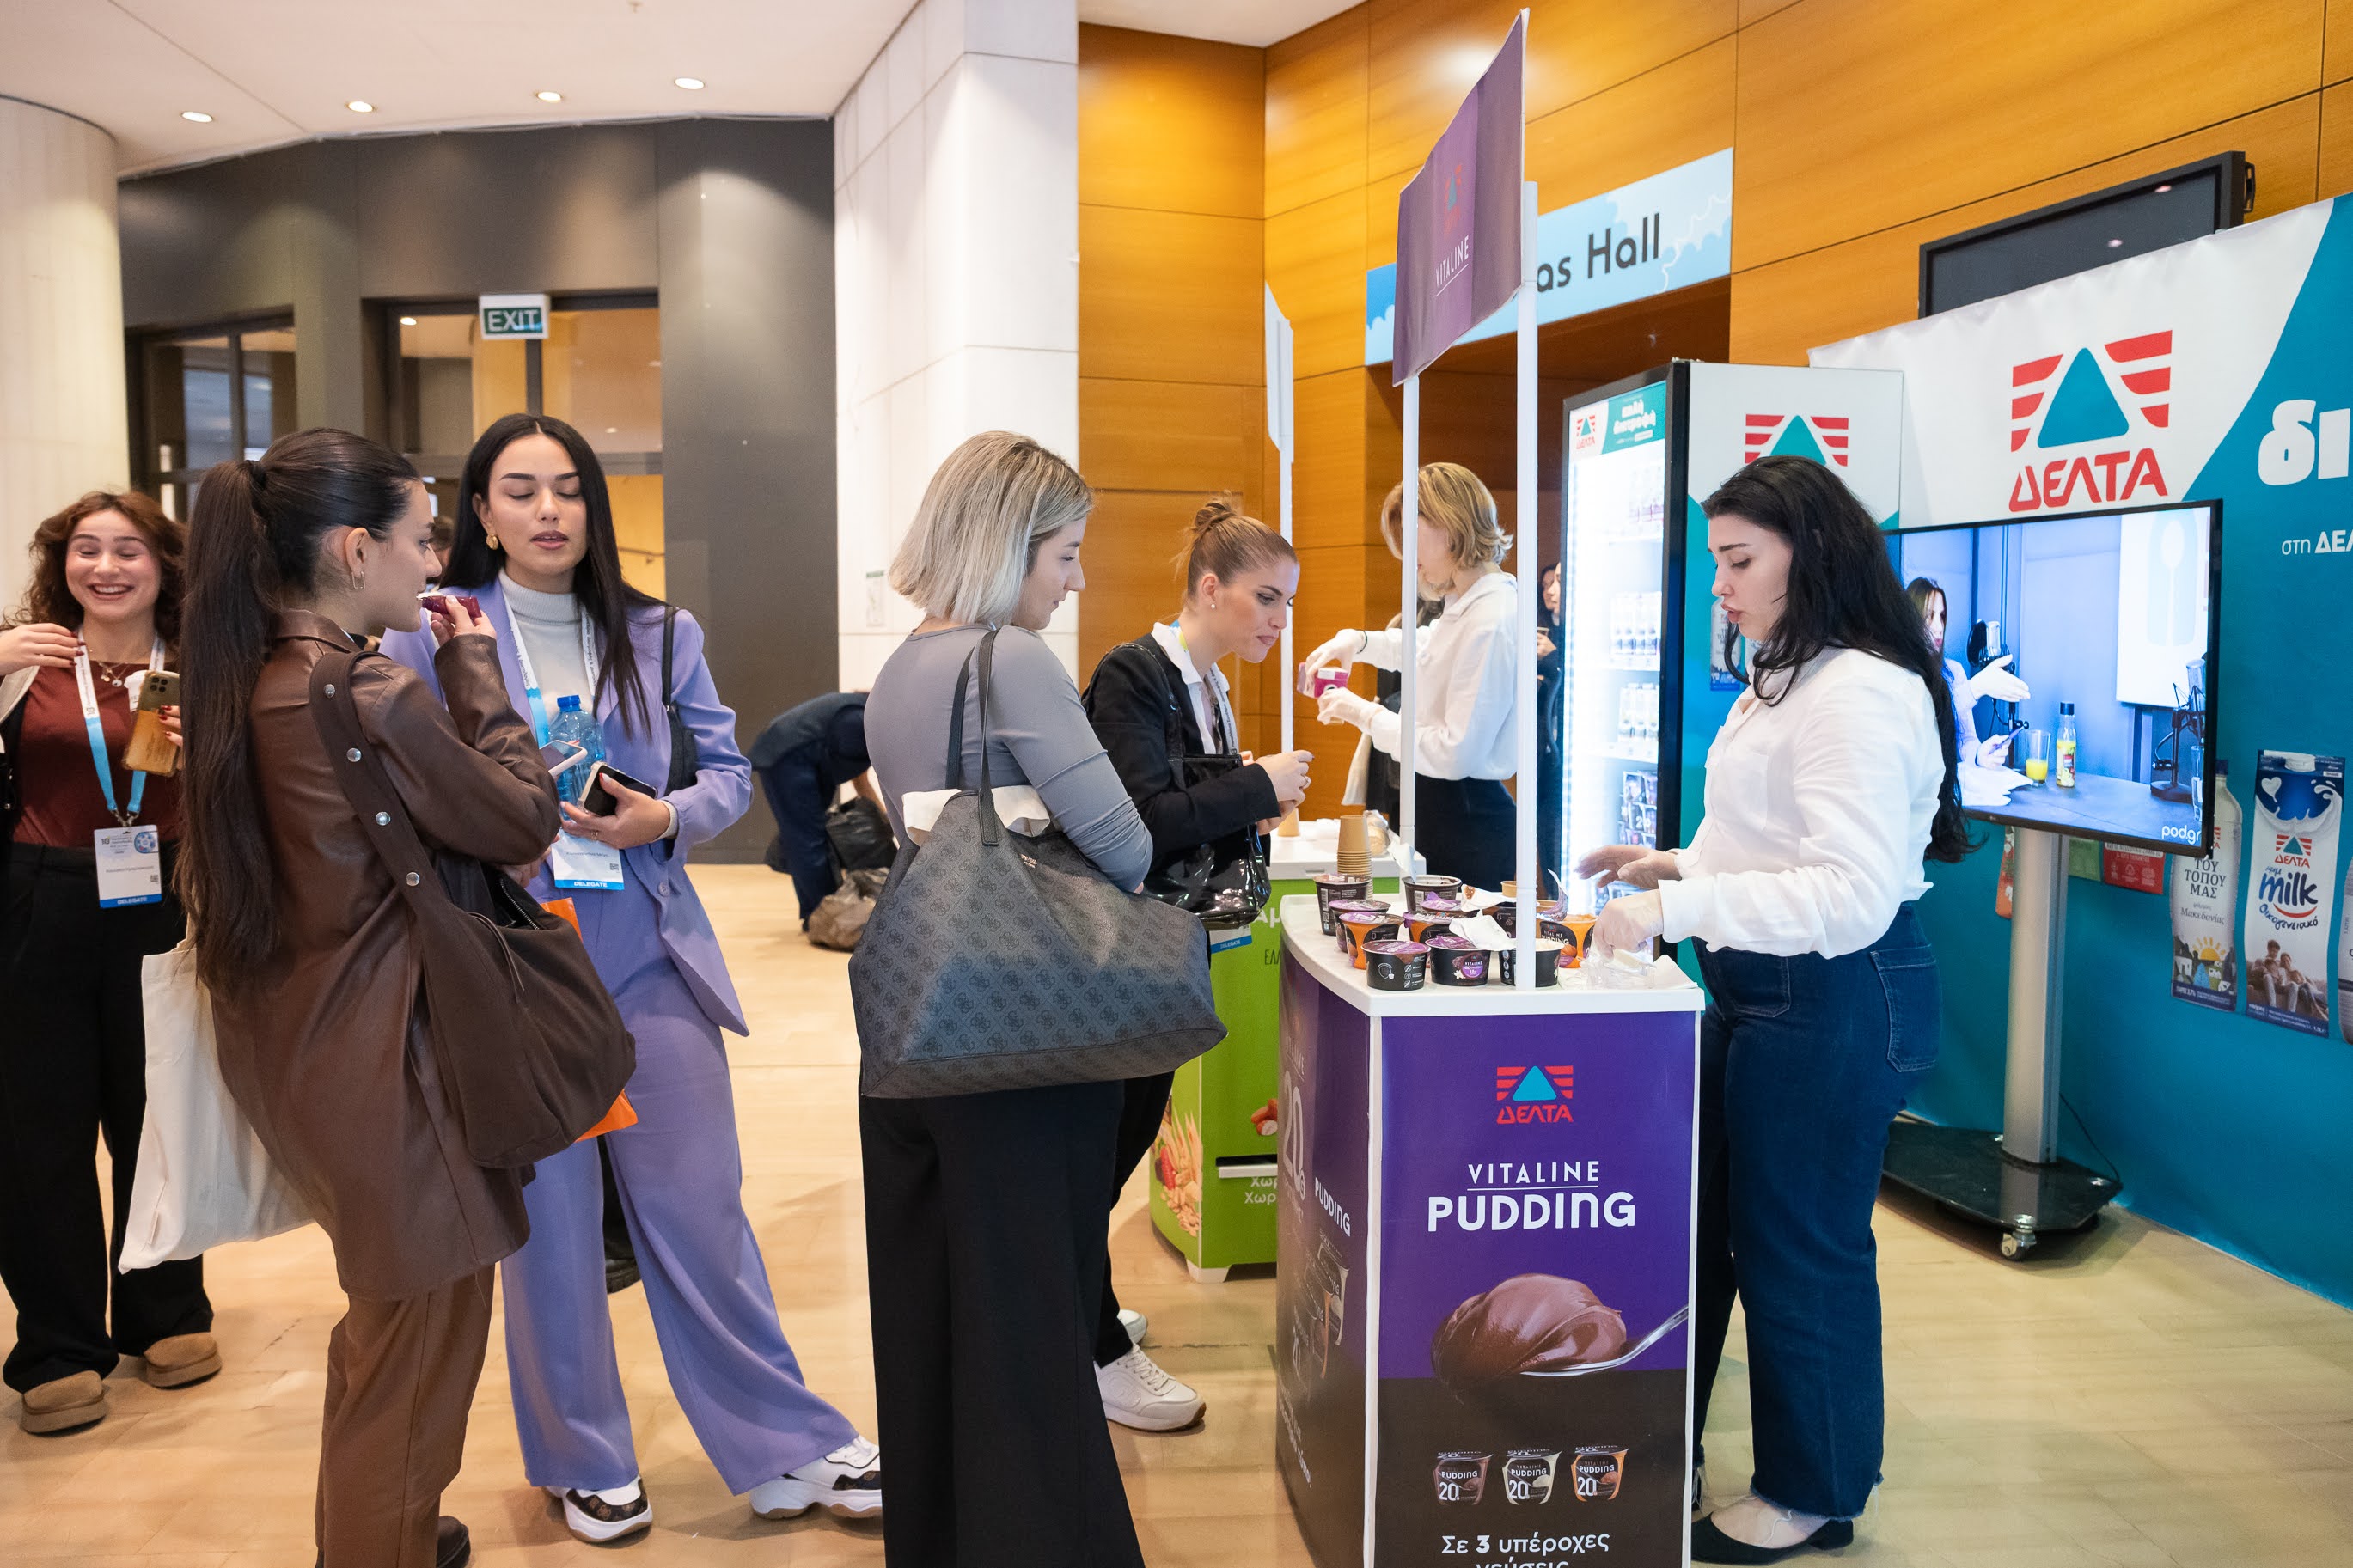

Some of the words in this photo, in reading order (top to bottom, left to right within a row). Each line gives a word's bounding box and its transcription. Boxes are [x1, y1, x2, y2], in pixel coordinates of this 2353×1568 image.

[1587, 212, 1660, 279] Hall
[1435, 235, 1470, 288] VITALINE
[487, 309, 539, 332] EXIT
[2008, 447, 2169, 513] ΔΕΛΤΑ
[2281, 538, 2312, 556] στη
[2161, 824, 2201, 845] pod.gr
[2194, 858, 2220, 873] ΤΟΥ
[2274, 854, 2311, 869] ΔΕΛΤΑ
[2185, 869, 2228, 888] ΤΟΠΟΥ
[2258, 871, 2319, 906] milk
[117, 896, 148, 905] DELEGATE
[2190, 883, 2218, 900] ΜΑΣ
[2180, 906, 2225, 926] Μακεδονίας
[1220, 939, 1241, 949] DELEGATE
[1496, 1104, 1574, 1125] ΔΕΛΤΑ
[1468, 1161, 1599, 1184] VITALINE
[1441, 1535, 1469, 1554] Σε
[1476, 1534, 1490, 1553] 3
[1499, 1532, 1610, 1557] υπέροχες
